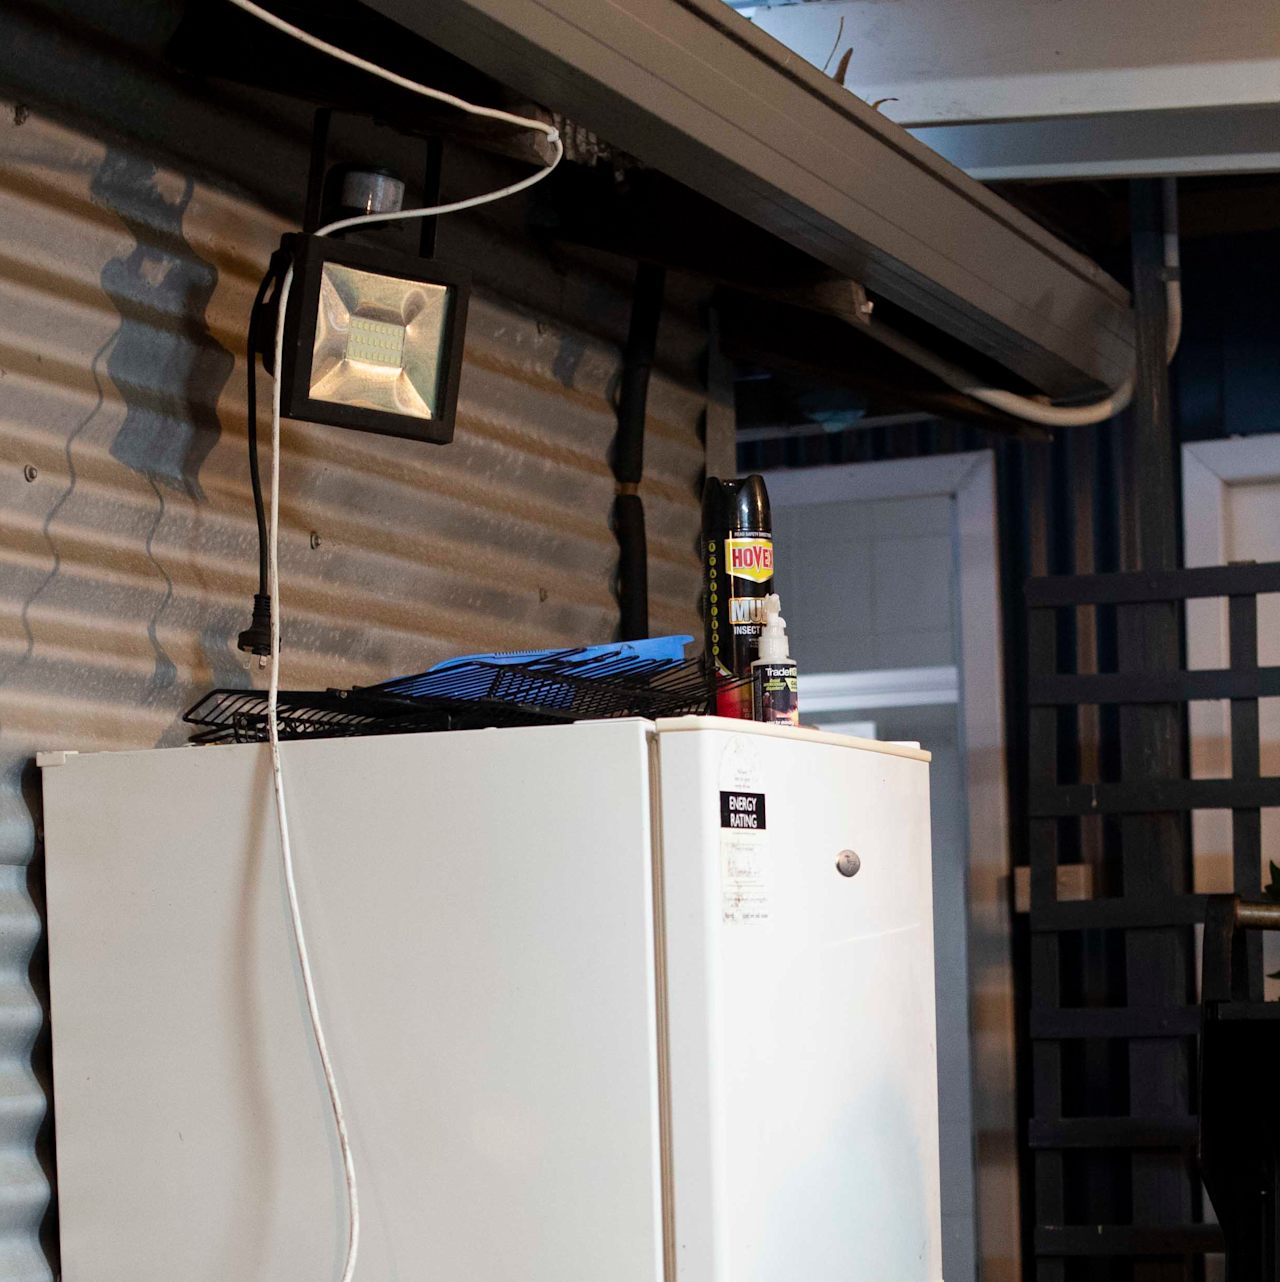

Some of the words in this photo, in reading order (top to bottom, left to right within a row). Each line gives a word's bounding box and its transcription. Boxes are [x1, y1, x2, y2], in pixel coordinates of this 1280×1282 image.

[733, 625, 761, 635] INSECT
[728, 796, 758, 812] ENERGY
[730, 813, 758, 829] RATING
